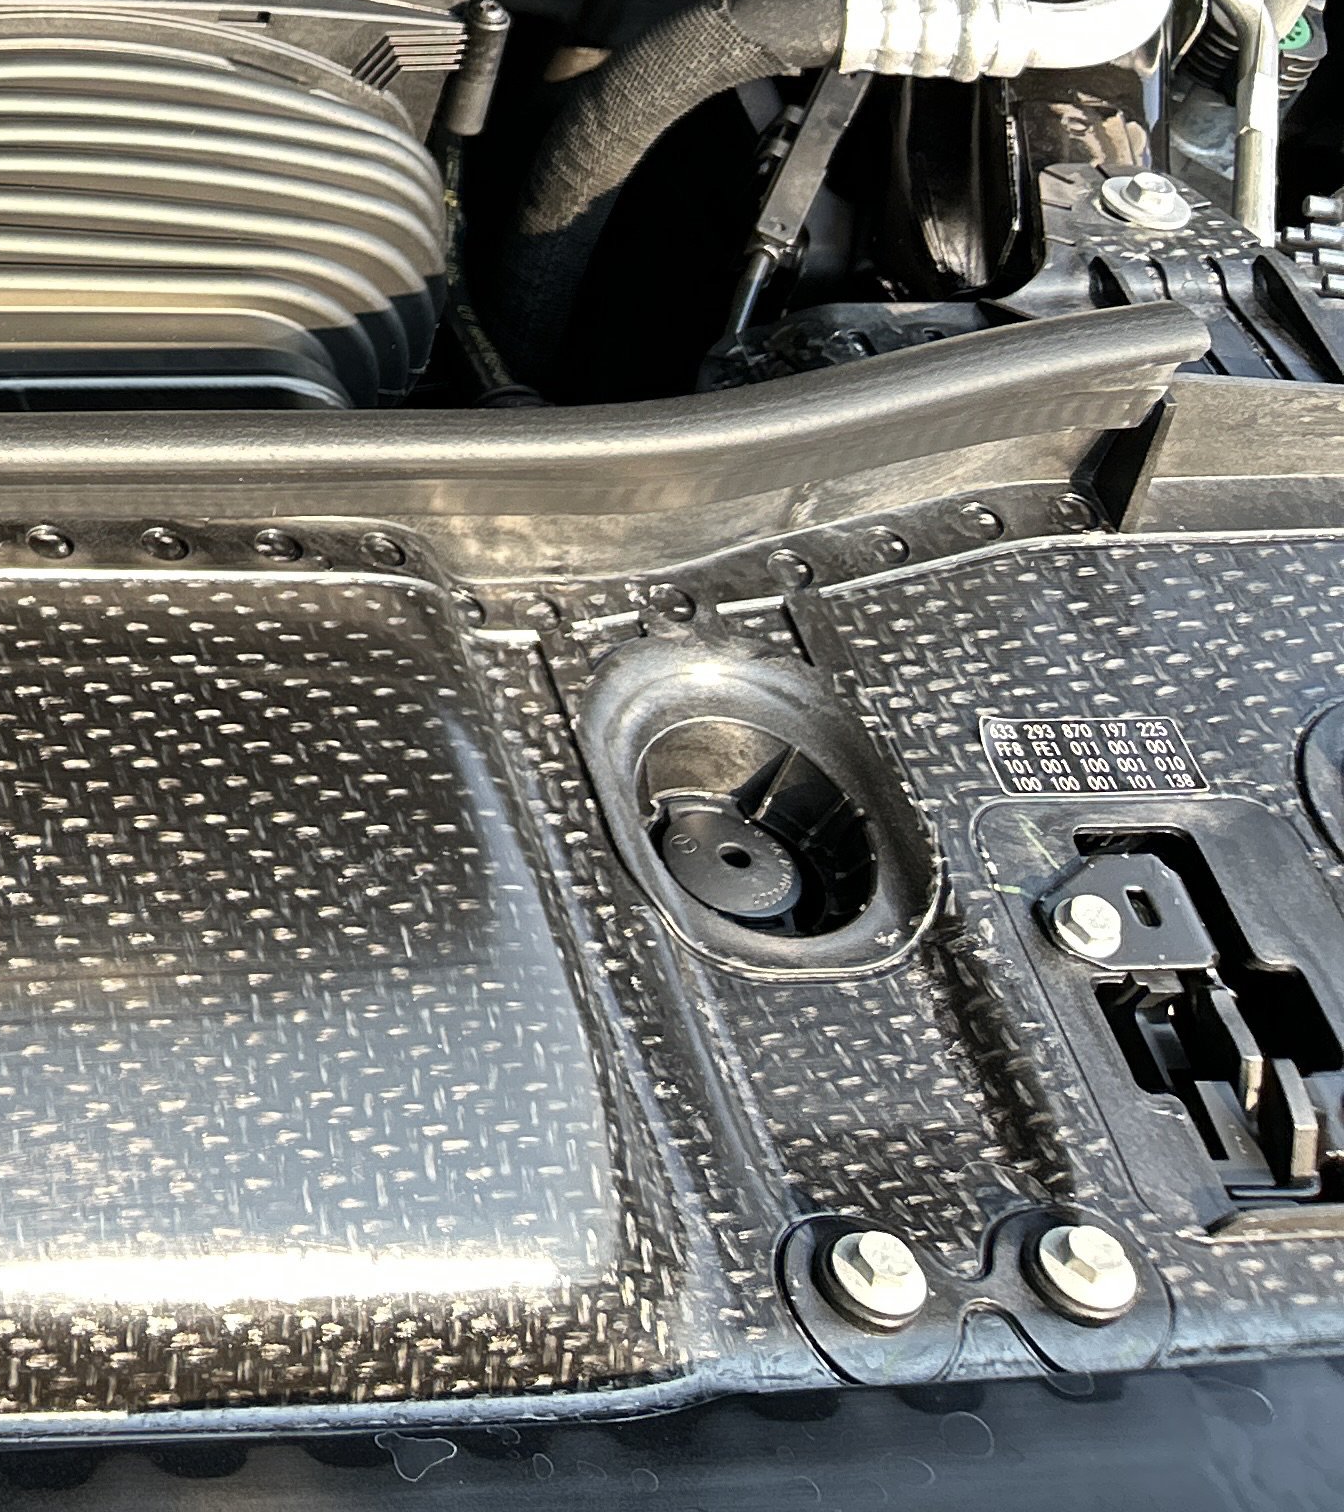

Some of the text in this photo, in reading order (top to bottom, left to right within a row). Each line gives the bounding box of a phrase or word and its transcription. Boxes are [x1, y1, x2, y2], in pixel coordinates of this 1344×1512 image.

[990, 721, 1168, 739] 633 293 870 197 225
[994, 739, 1176, 756] FF8 FE1 011 001 001
[1003, 755, 1186, 774] 101 001 100 001 010
[1012, 773, 1196, 792] 100 100 001 101 138
